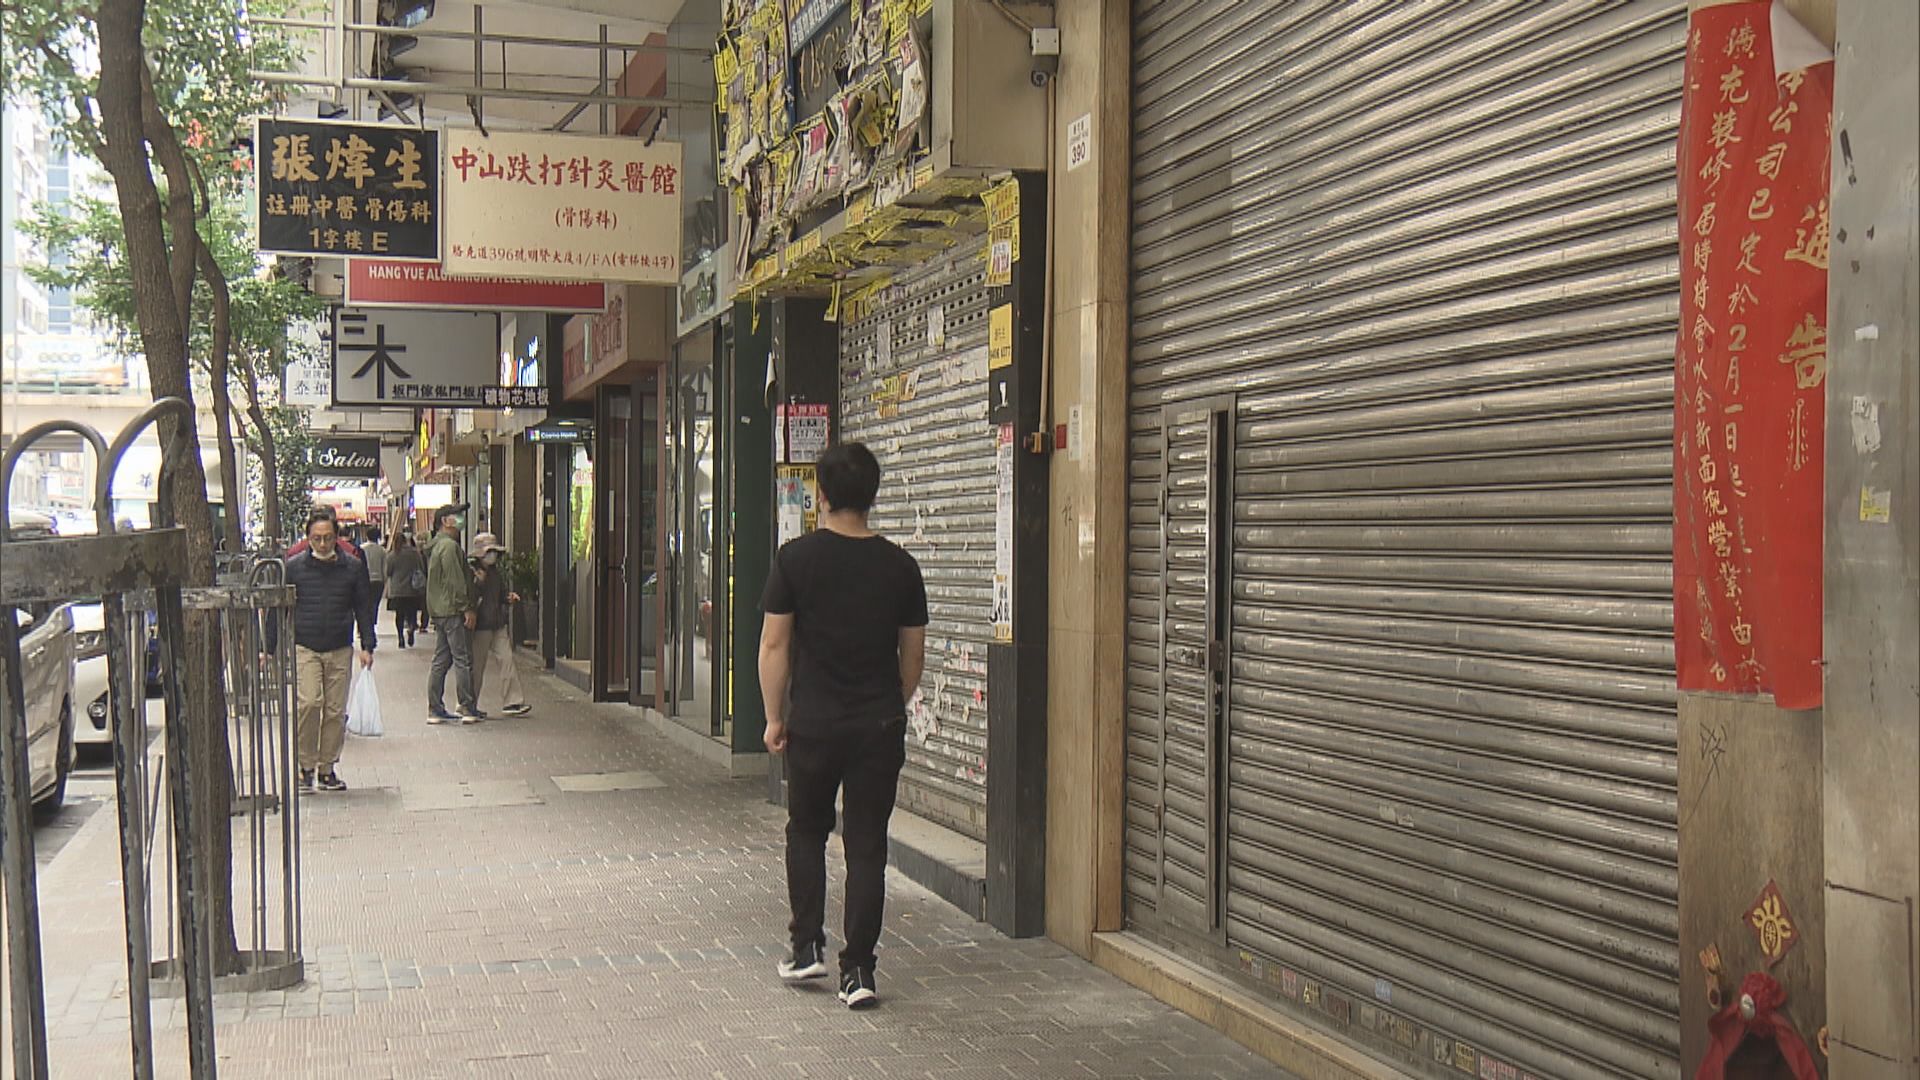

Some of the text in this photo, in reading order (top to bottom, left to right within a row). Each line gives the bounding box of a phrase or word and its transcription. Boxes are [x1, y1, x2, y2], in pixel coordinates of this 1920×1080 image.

[271, 133, 428, 190] 張煒生
[1072, 141, 1086, 165] 390
[452, 147, 678, 195] 中山跌打針灸醫館
[372, 231, 389, 251] E
[368, 265, 401, 279] HANG
[403, 266, 425, 280] YUE
[319, 447, 377, 468] Salon
